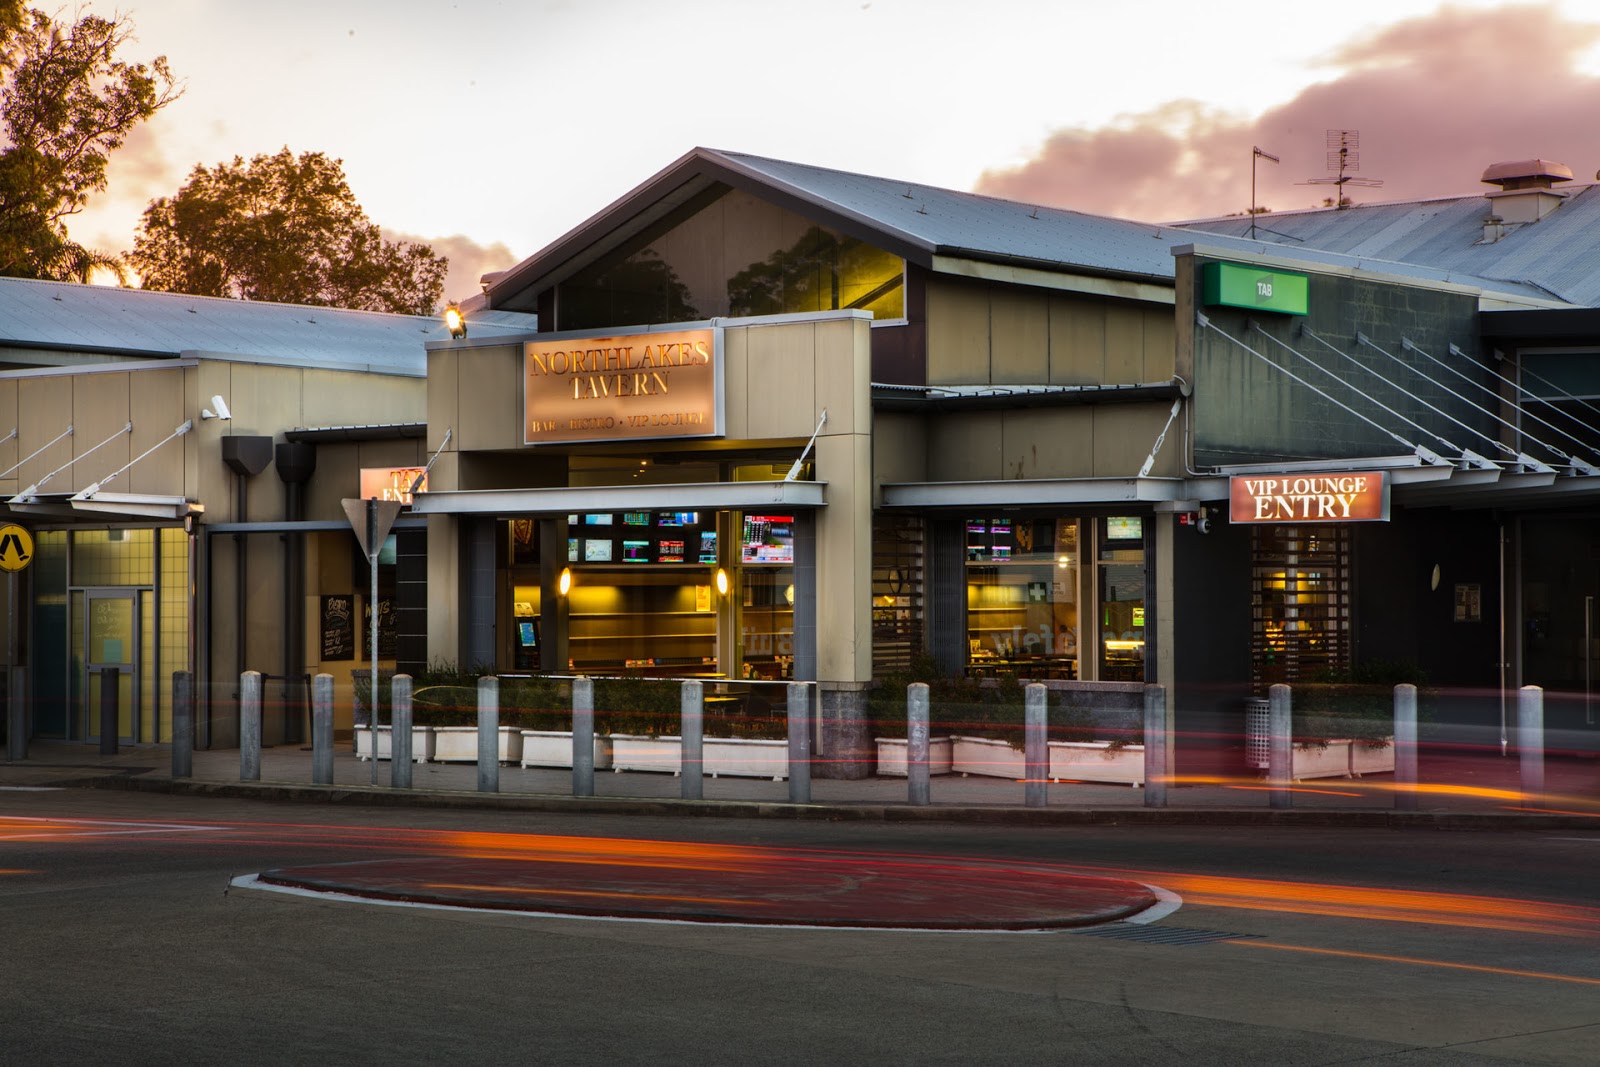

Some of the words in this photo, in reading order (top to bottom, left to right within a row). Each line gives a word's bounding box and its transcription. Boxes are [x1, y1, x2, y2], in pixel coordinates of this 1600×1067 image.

[1257, 282, 1272, 297] TAB
[530, 341, 709, 376] NORTHLAKES
[568, 371, 671, 400] TAVERN
[532, 420, 557, 433] BAR
[569, 416, 614, 431] BISTRO
[627, 415, 649, 428] VIP
[652, 412, 707, 427] LOUNGE
[383, 488, 427, 504] ENT
[1245, 479, 1278, 496] VIP
[1282, 477, 1367, 495] LOUNGE
[1254, 493, 1357, 519] ENTRY
